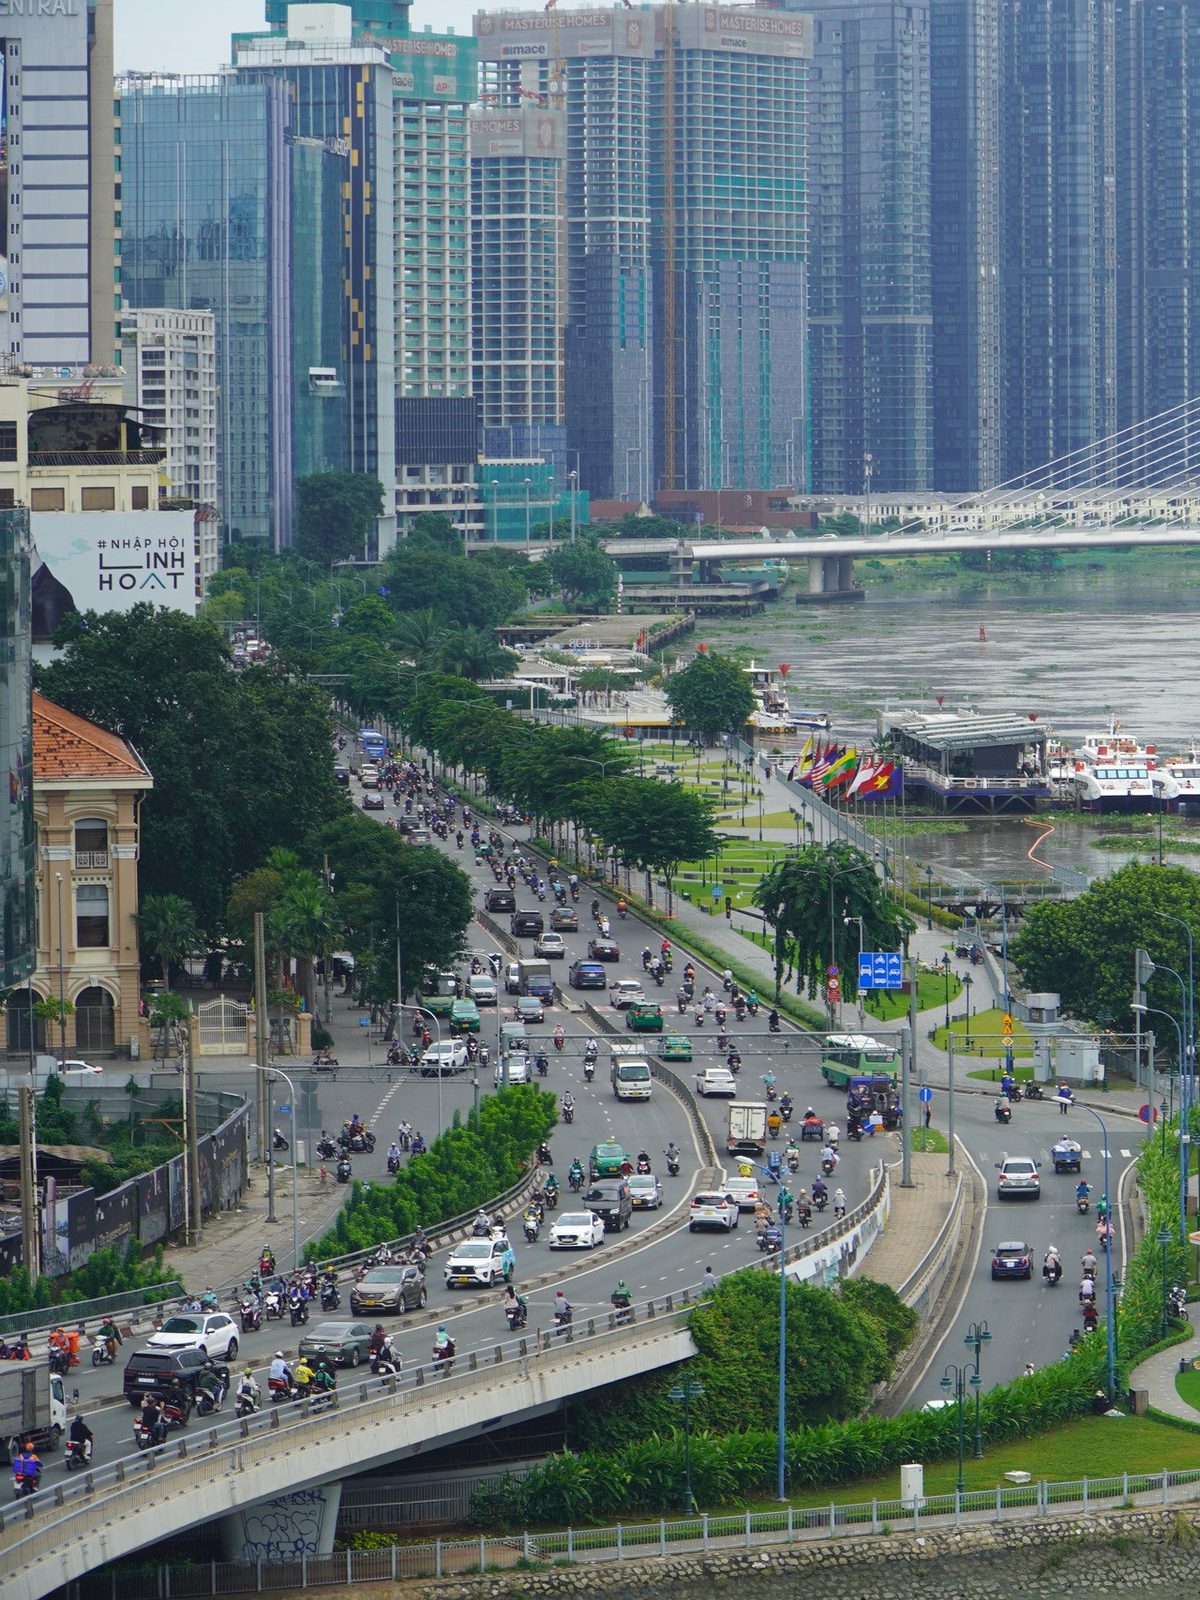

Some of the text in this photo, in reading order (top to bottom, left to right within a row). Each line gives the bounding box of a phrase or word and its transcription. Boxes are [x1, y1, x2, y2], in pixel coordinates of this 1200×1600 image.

[505, 15, 606, 30] MASTERISE HOMES
[721, 15, 802, 35] MASTERISE HOMES
[480, 120, 520, 132] HOMES
[158, 536, 184, 550] HỘI
[99, 551, 184, 570] LINH
